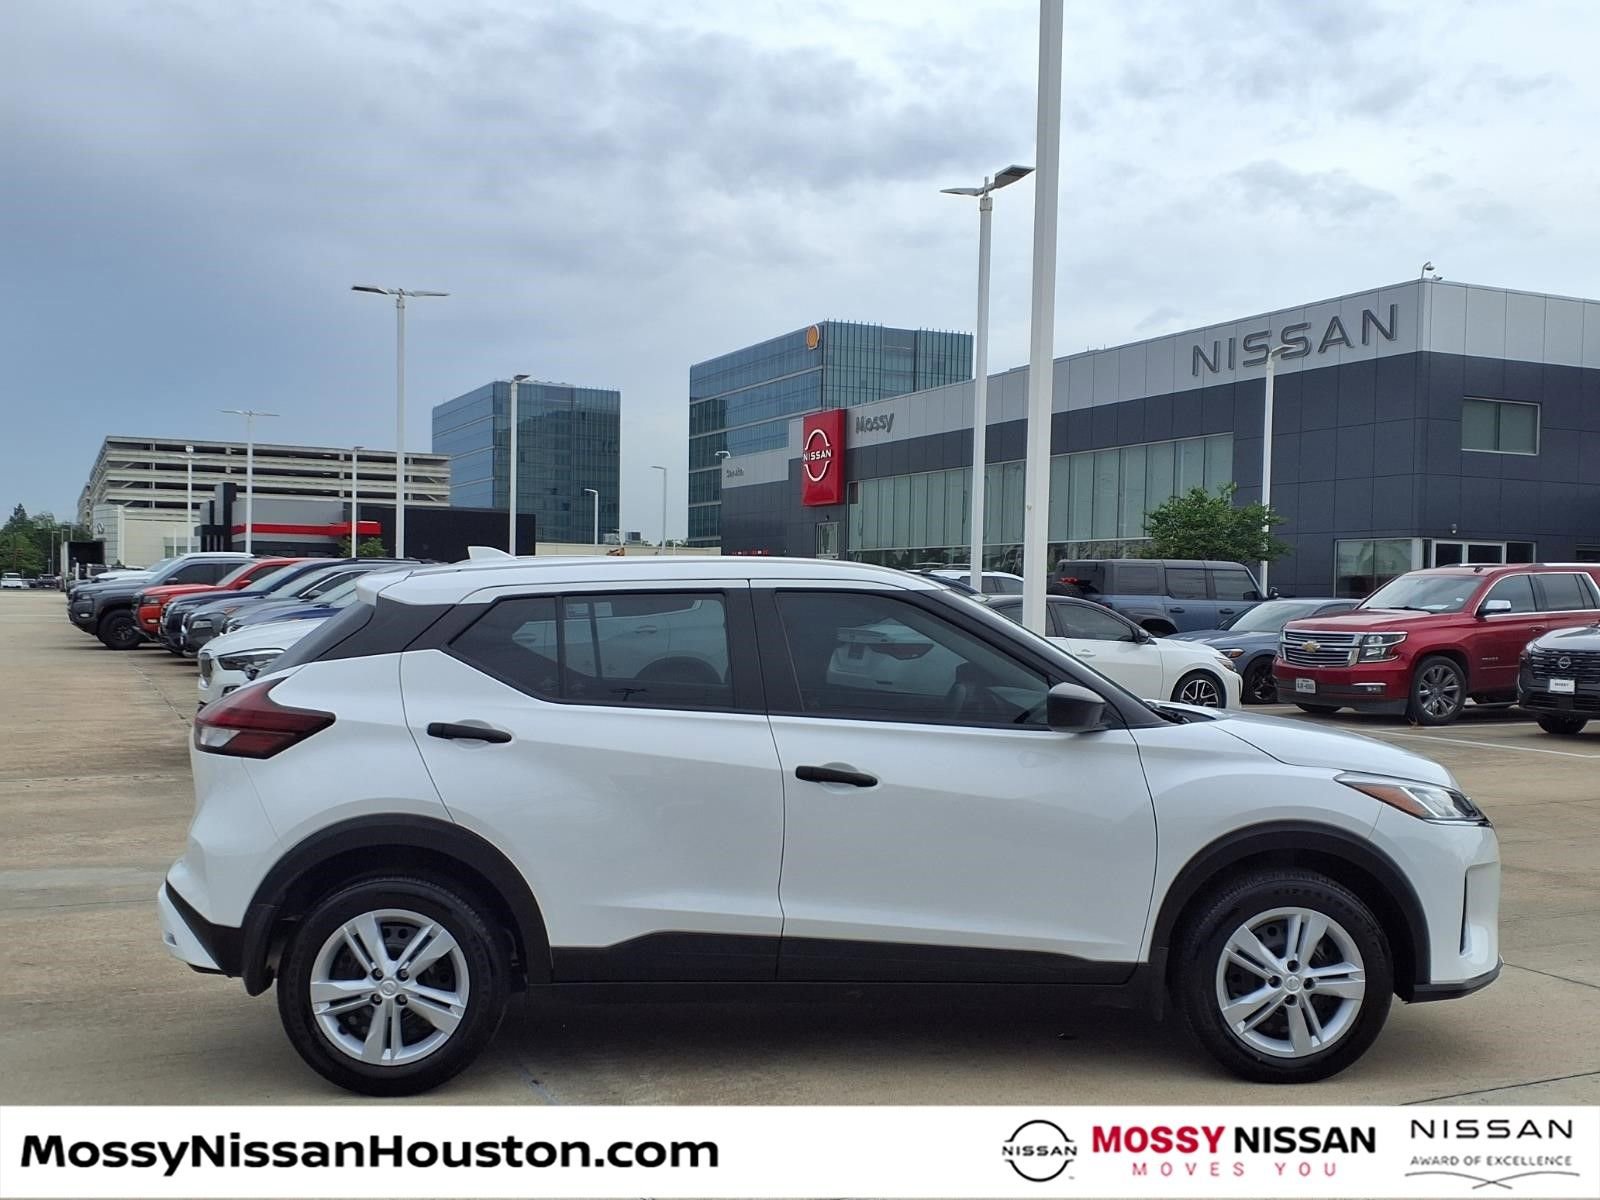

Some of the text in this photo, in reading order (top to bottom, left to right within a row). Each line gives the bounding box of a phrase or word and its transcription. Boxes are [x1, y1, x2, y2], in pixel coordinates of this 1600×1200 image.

[1192, 304, 1398, 376] NISSAN
[856, 412, 895, 434] Mossy
[803, 449, 832, 462] NISSAN
